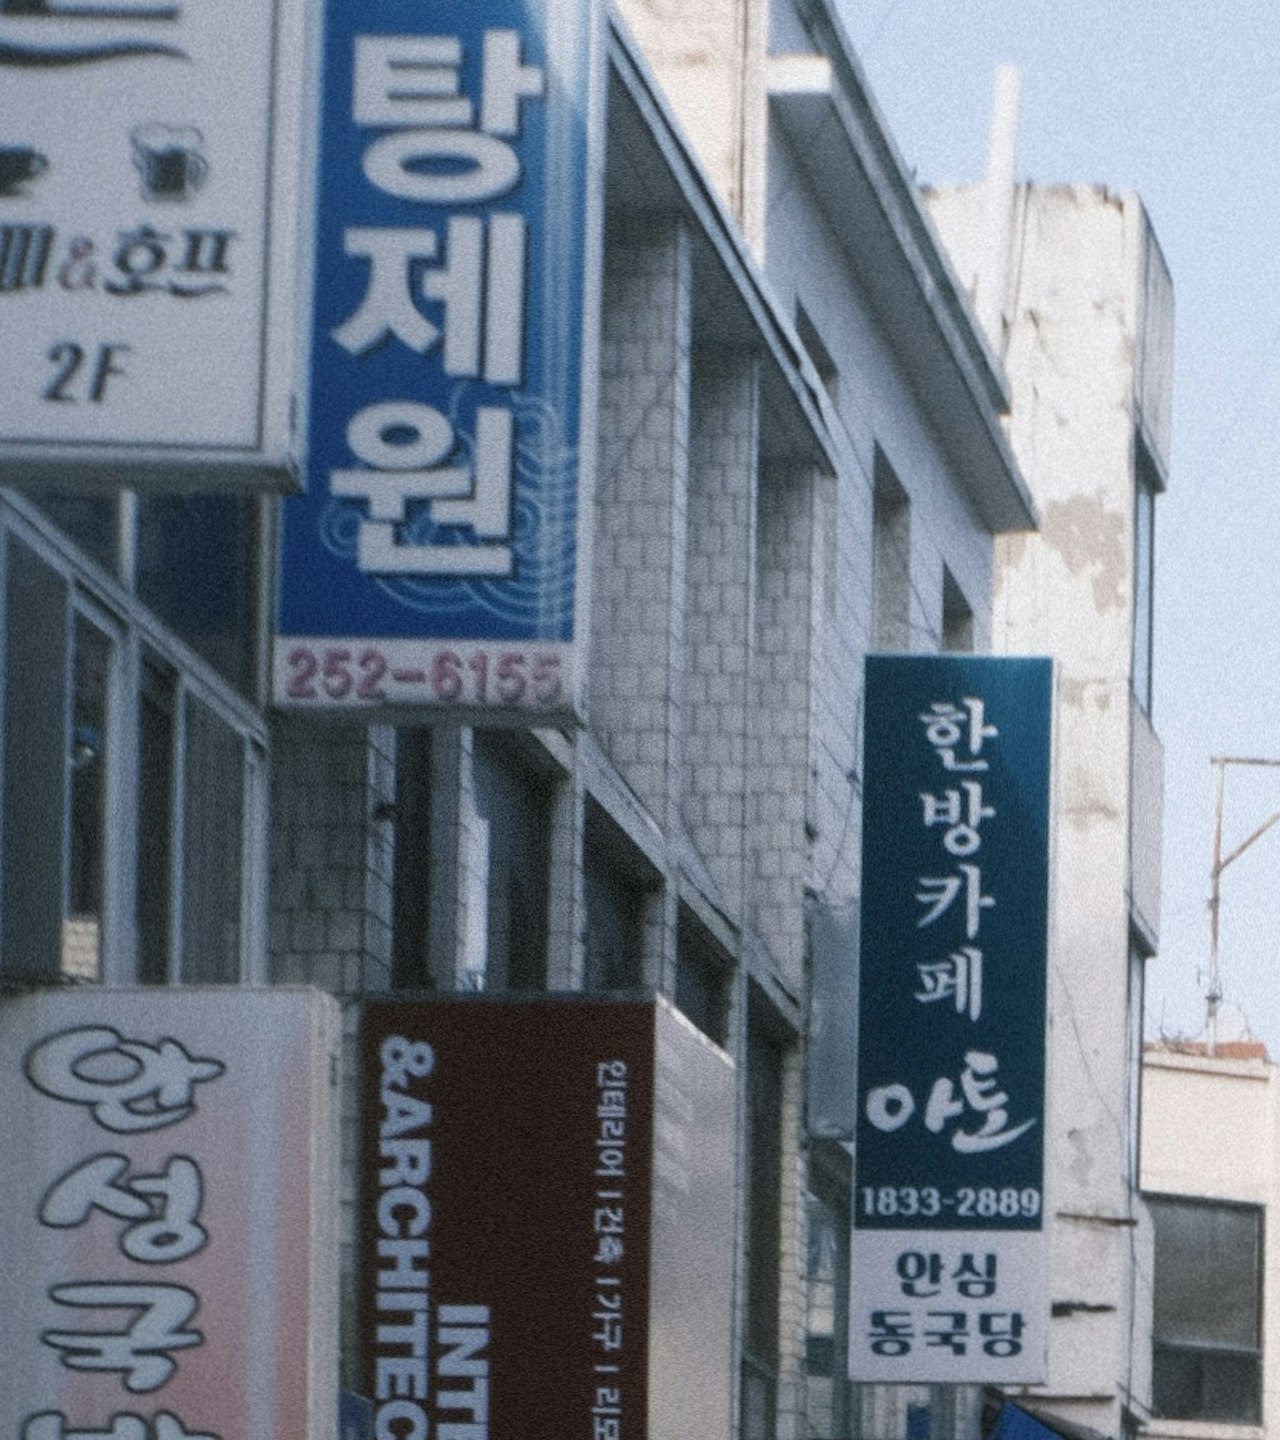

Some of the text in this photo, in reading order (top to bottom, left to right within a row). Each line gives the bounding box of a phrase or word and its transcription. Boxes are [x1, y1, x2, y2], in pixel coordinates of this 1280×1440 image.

[43, 340, 133, 402] 2F
[284, 641, 564, 707] 252-6155
[914, 696, 1001, 1023] 한방카페
[596, 1060, 627, 1179] 인테리어
[895, 1248, 1001, 1301] 안심
[593, 1292, 623, 1352] 가구
[868, 1308, 1028, 1360] 동국당
